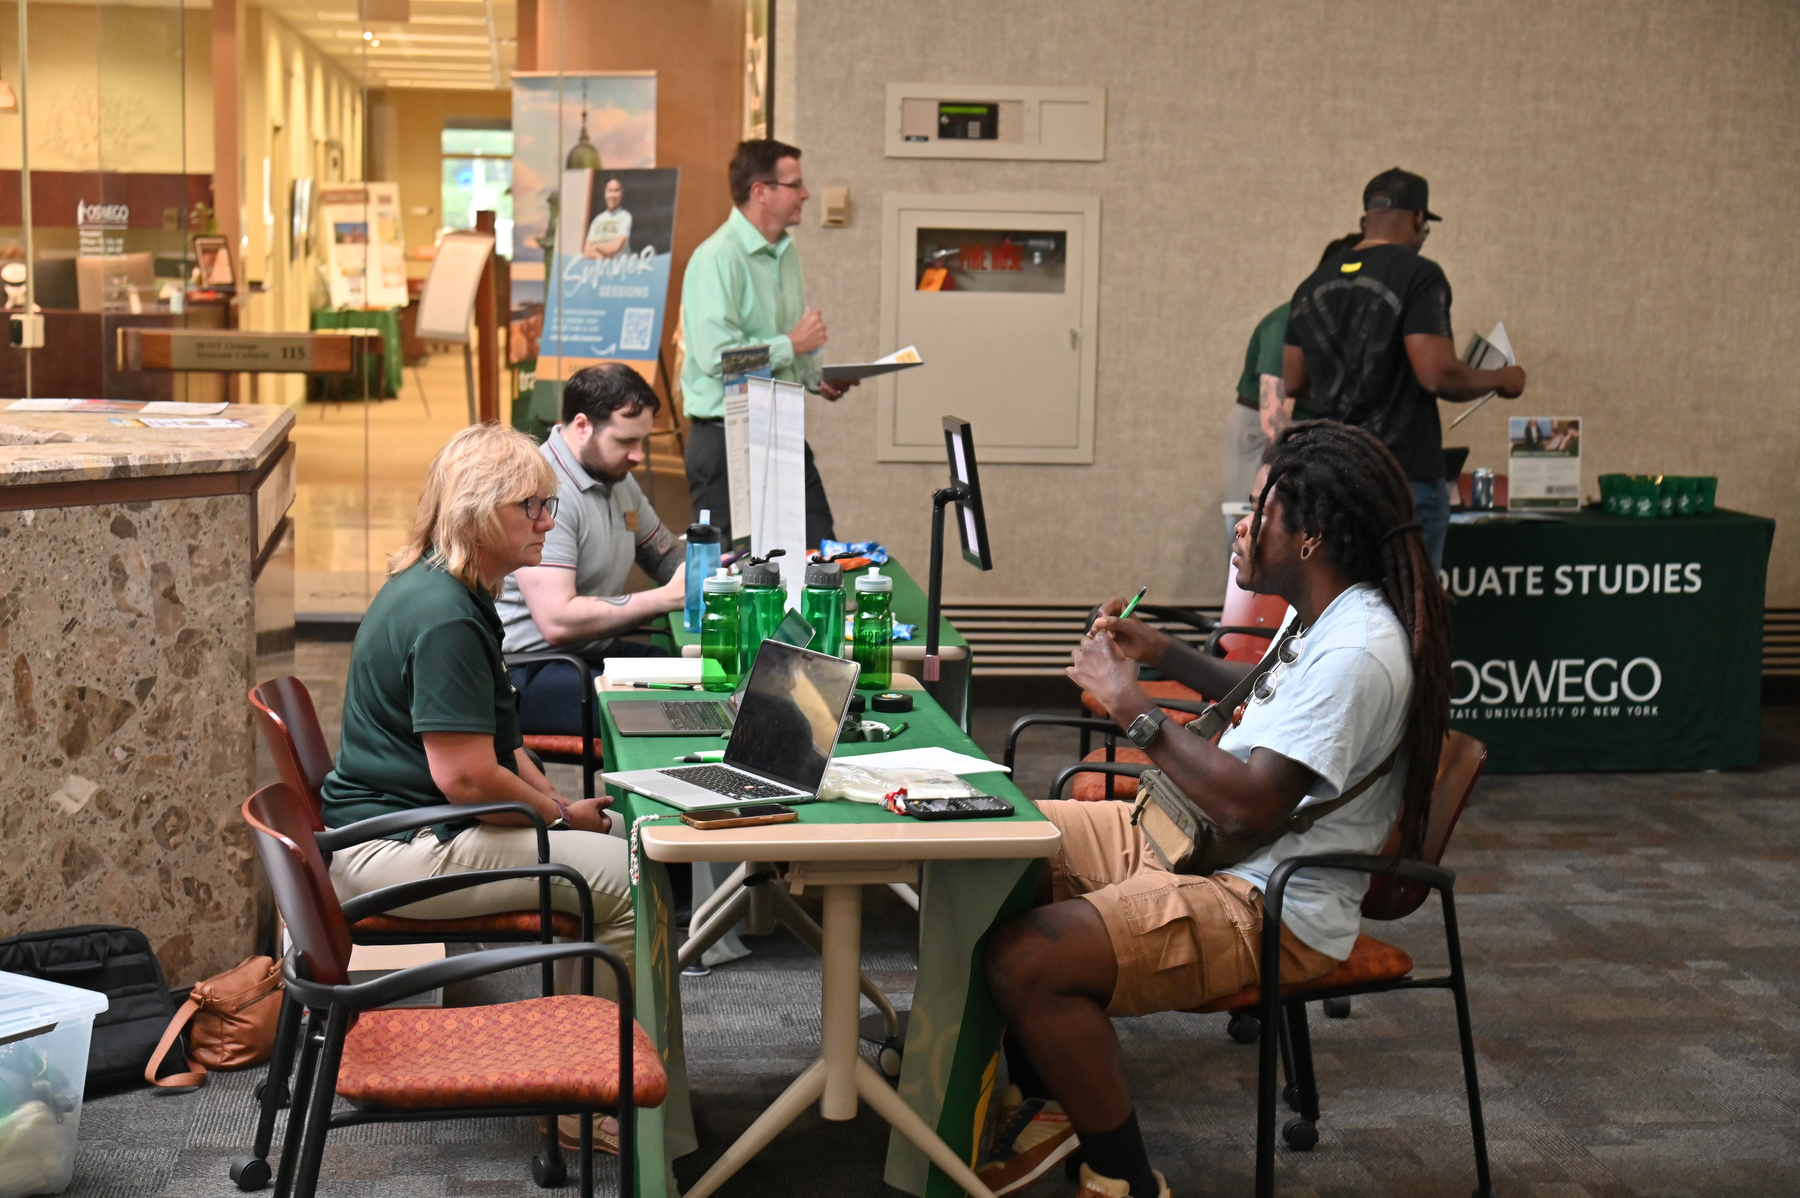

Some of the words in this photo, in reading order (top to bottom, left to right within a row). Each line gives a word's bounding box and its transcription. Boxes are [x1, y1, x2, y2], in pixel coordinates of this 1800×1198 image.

[282, 346, 306, 360] 115
[1554, 562, 1702, 596] STUDIES
[1450, 656, 1662, 705] OSWEGO
[1450, 707, 1478, 720] TATE
[1485, 706, 1565, 719] UNIVERSITY
[1572, 706, 1587, 717] OF
[1594, 706, 1620, 717] NEW
[1627, 705, 1659, 716] YORK
